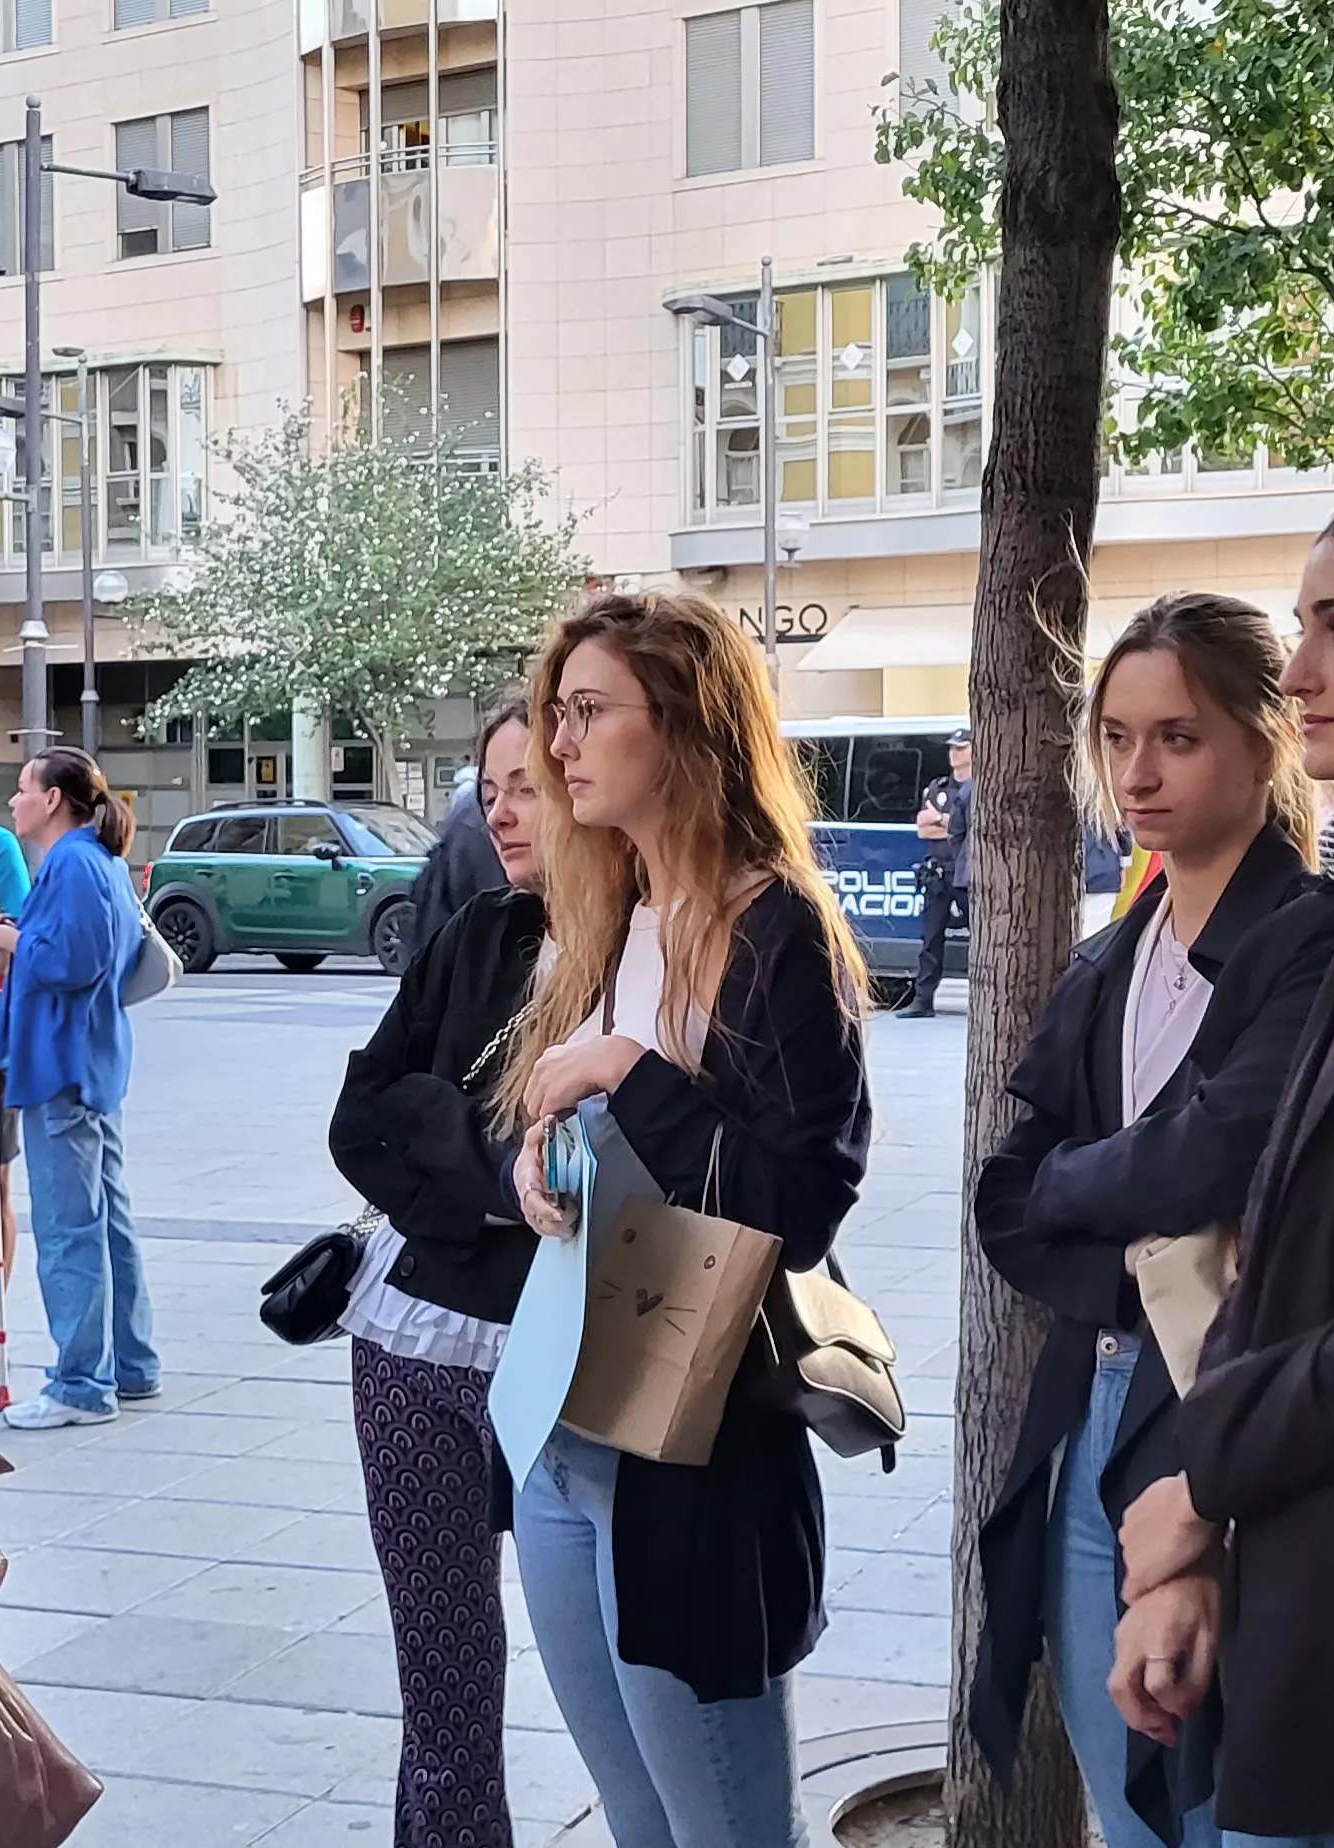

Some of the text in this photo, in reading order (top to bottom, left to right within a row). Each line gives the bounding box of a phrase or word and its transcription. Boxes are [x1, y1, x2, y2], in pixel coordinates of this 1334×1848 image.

[722, 604, 828, 635] NGO
[818, 870, 926, 893] POLIC
[835, 893, 925, 917] ACION
